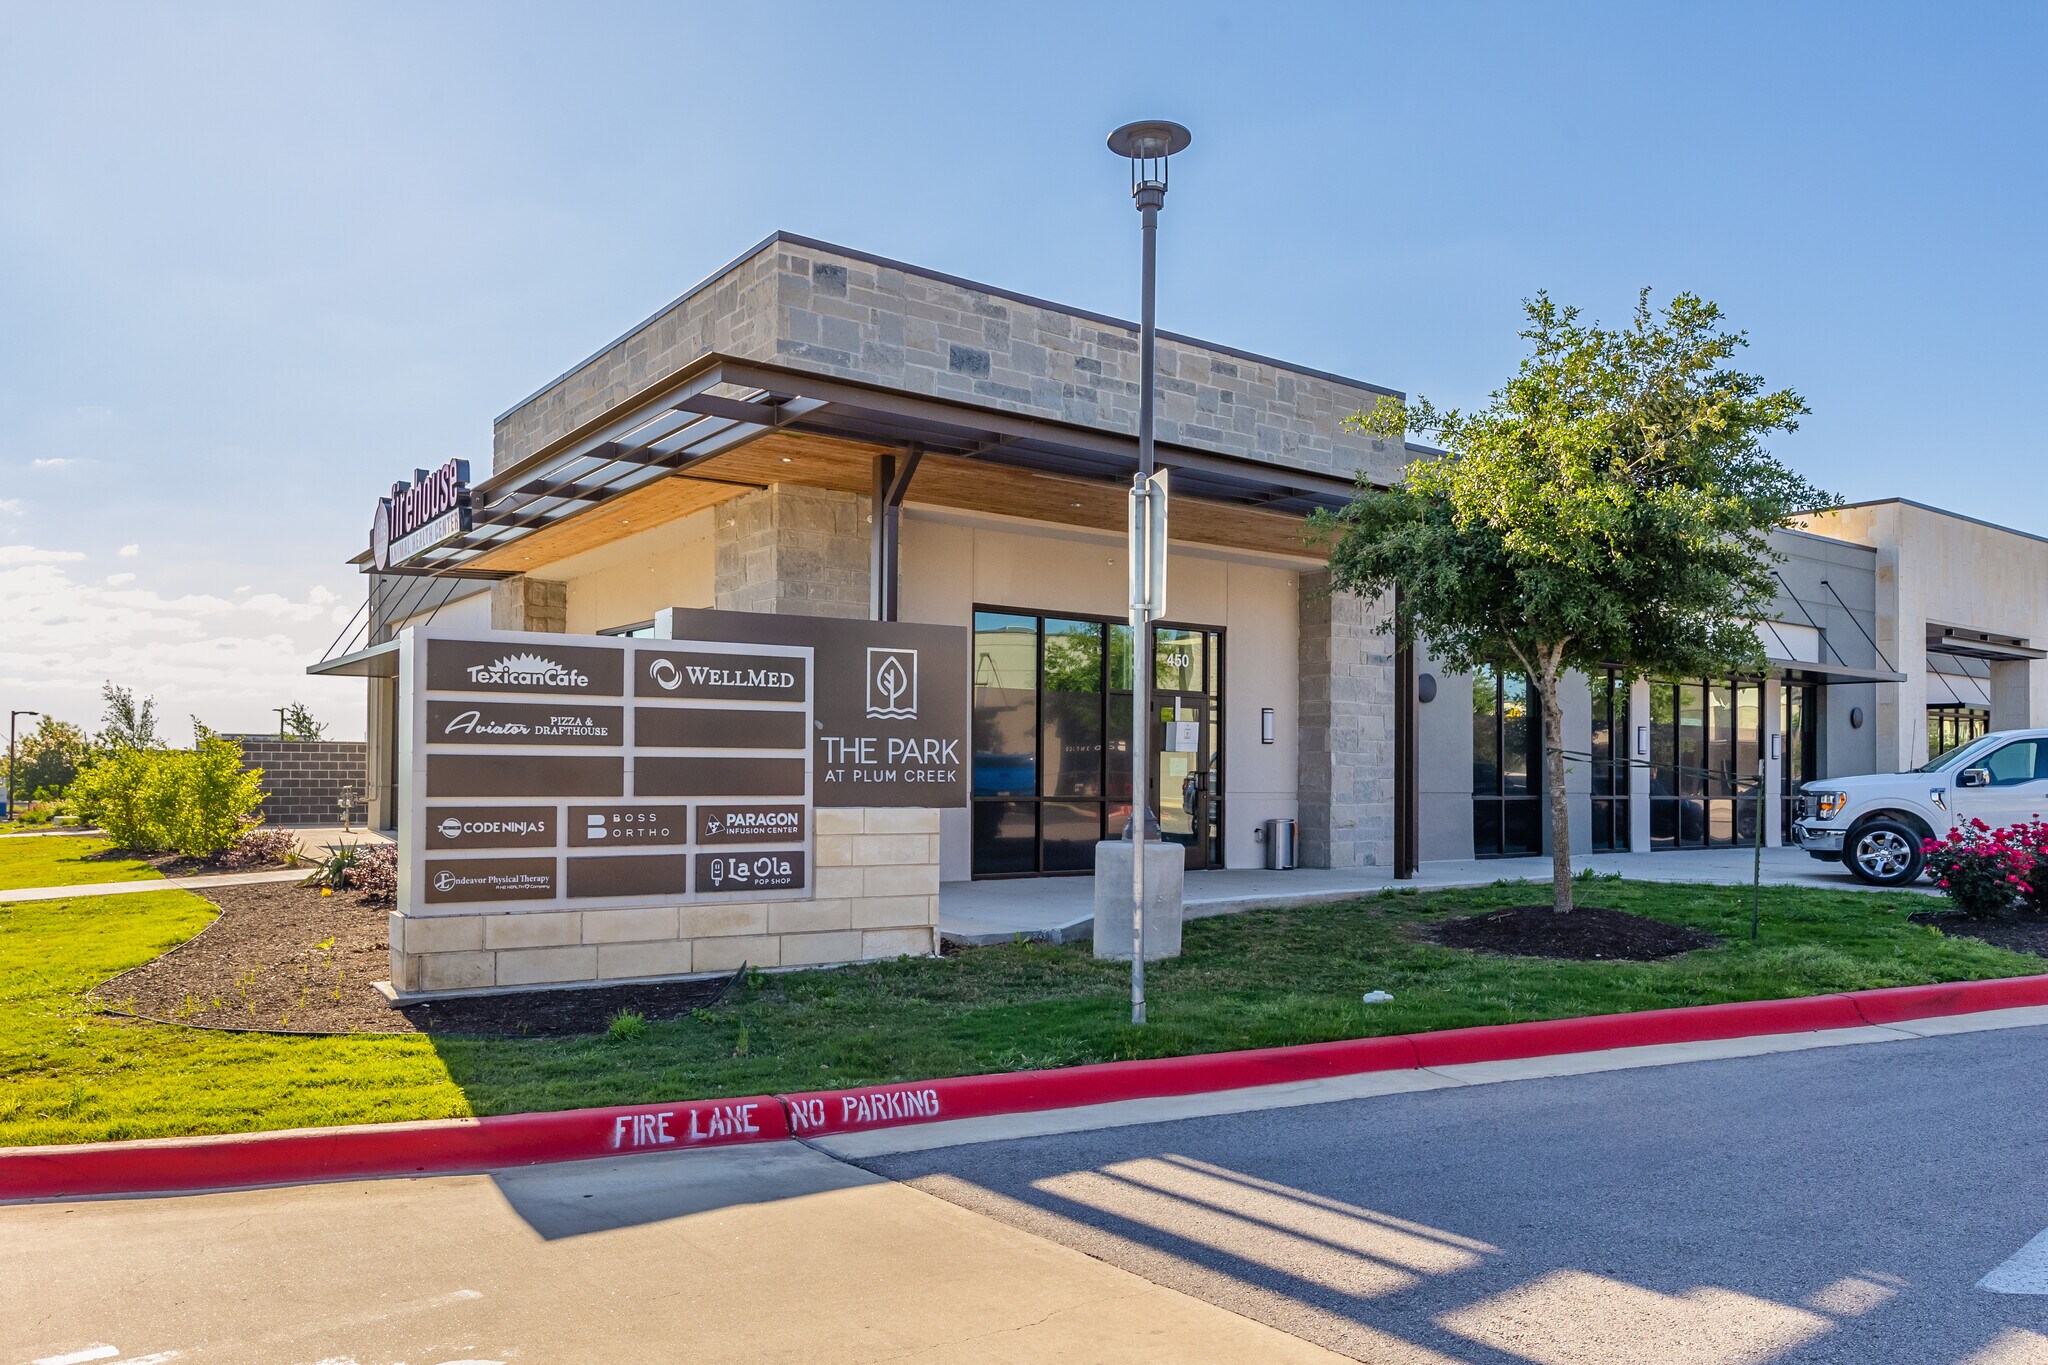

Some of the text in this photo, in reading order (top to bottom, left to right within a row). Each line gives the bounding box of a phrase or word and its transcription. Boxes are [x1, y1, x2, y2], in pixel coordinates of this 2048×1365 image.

[390, 458, 458, 541] firehouse
[434, 510, 459, 542] CENTER
[1166, 653, 1190, 668] 450
[444, 710, 531, 735] Aviator
[550, 716, 594, 727] PIZZA &
[534, 724, 609, 736] DRAFTHOUSE
[820, 736, 960, 765] THE PARK
[824, 769, 957, 783] AT PLUM CREEK
[613, 813, 657, 823] BOSS
[726, 812, 799, 827] PARAGON
[463, 821, 545, 836] CODE NINJAS
[612, 827, 670, 838] ORTHO
[767, 826, 798, 834] CENTER
[728, 857, 792, 882] La Ola
[438, 872, 550, 889] Endeavor Physical Therapy
[771, 877, 791, 885] SHOP
[614, 1088, 939, 1149] FIRE LANE NO PARKING
